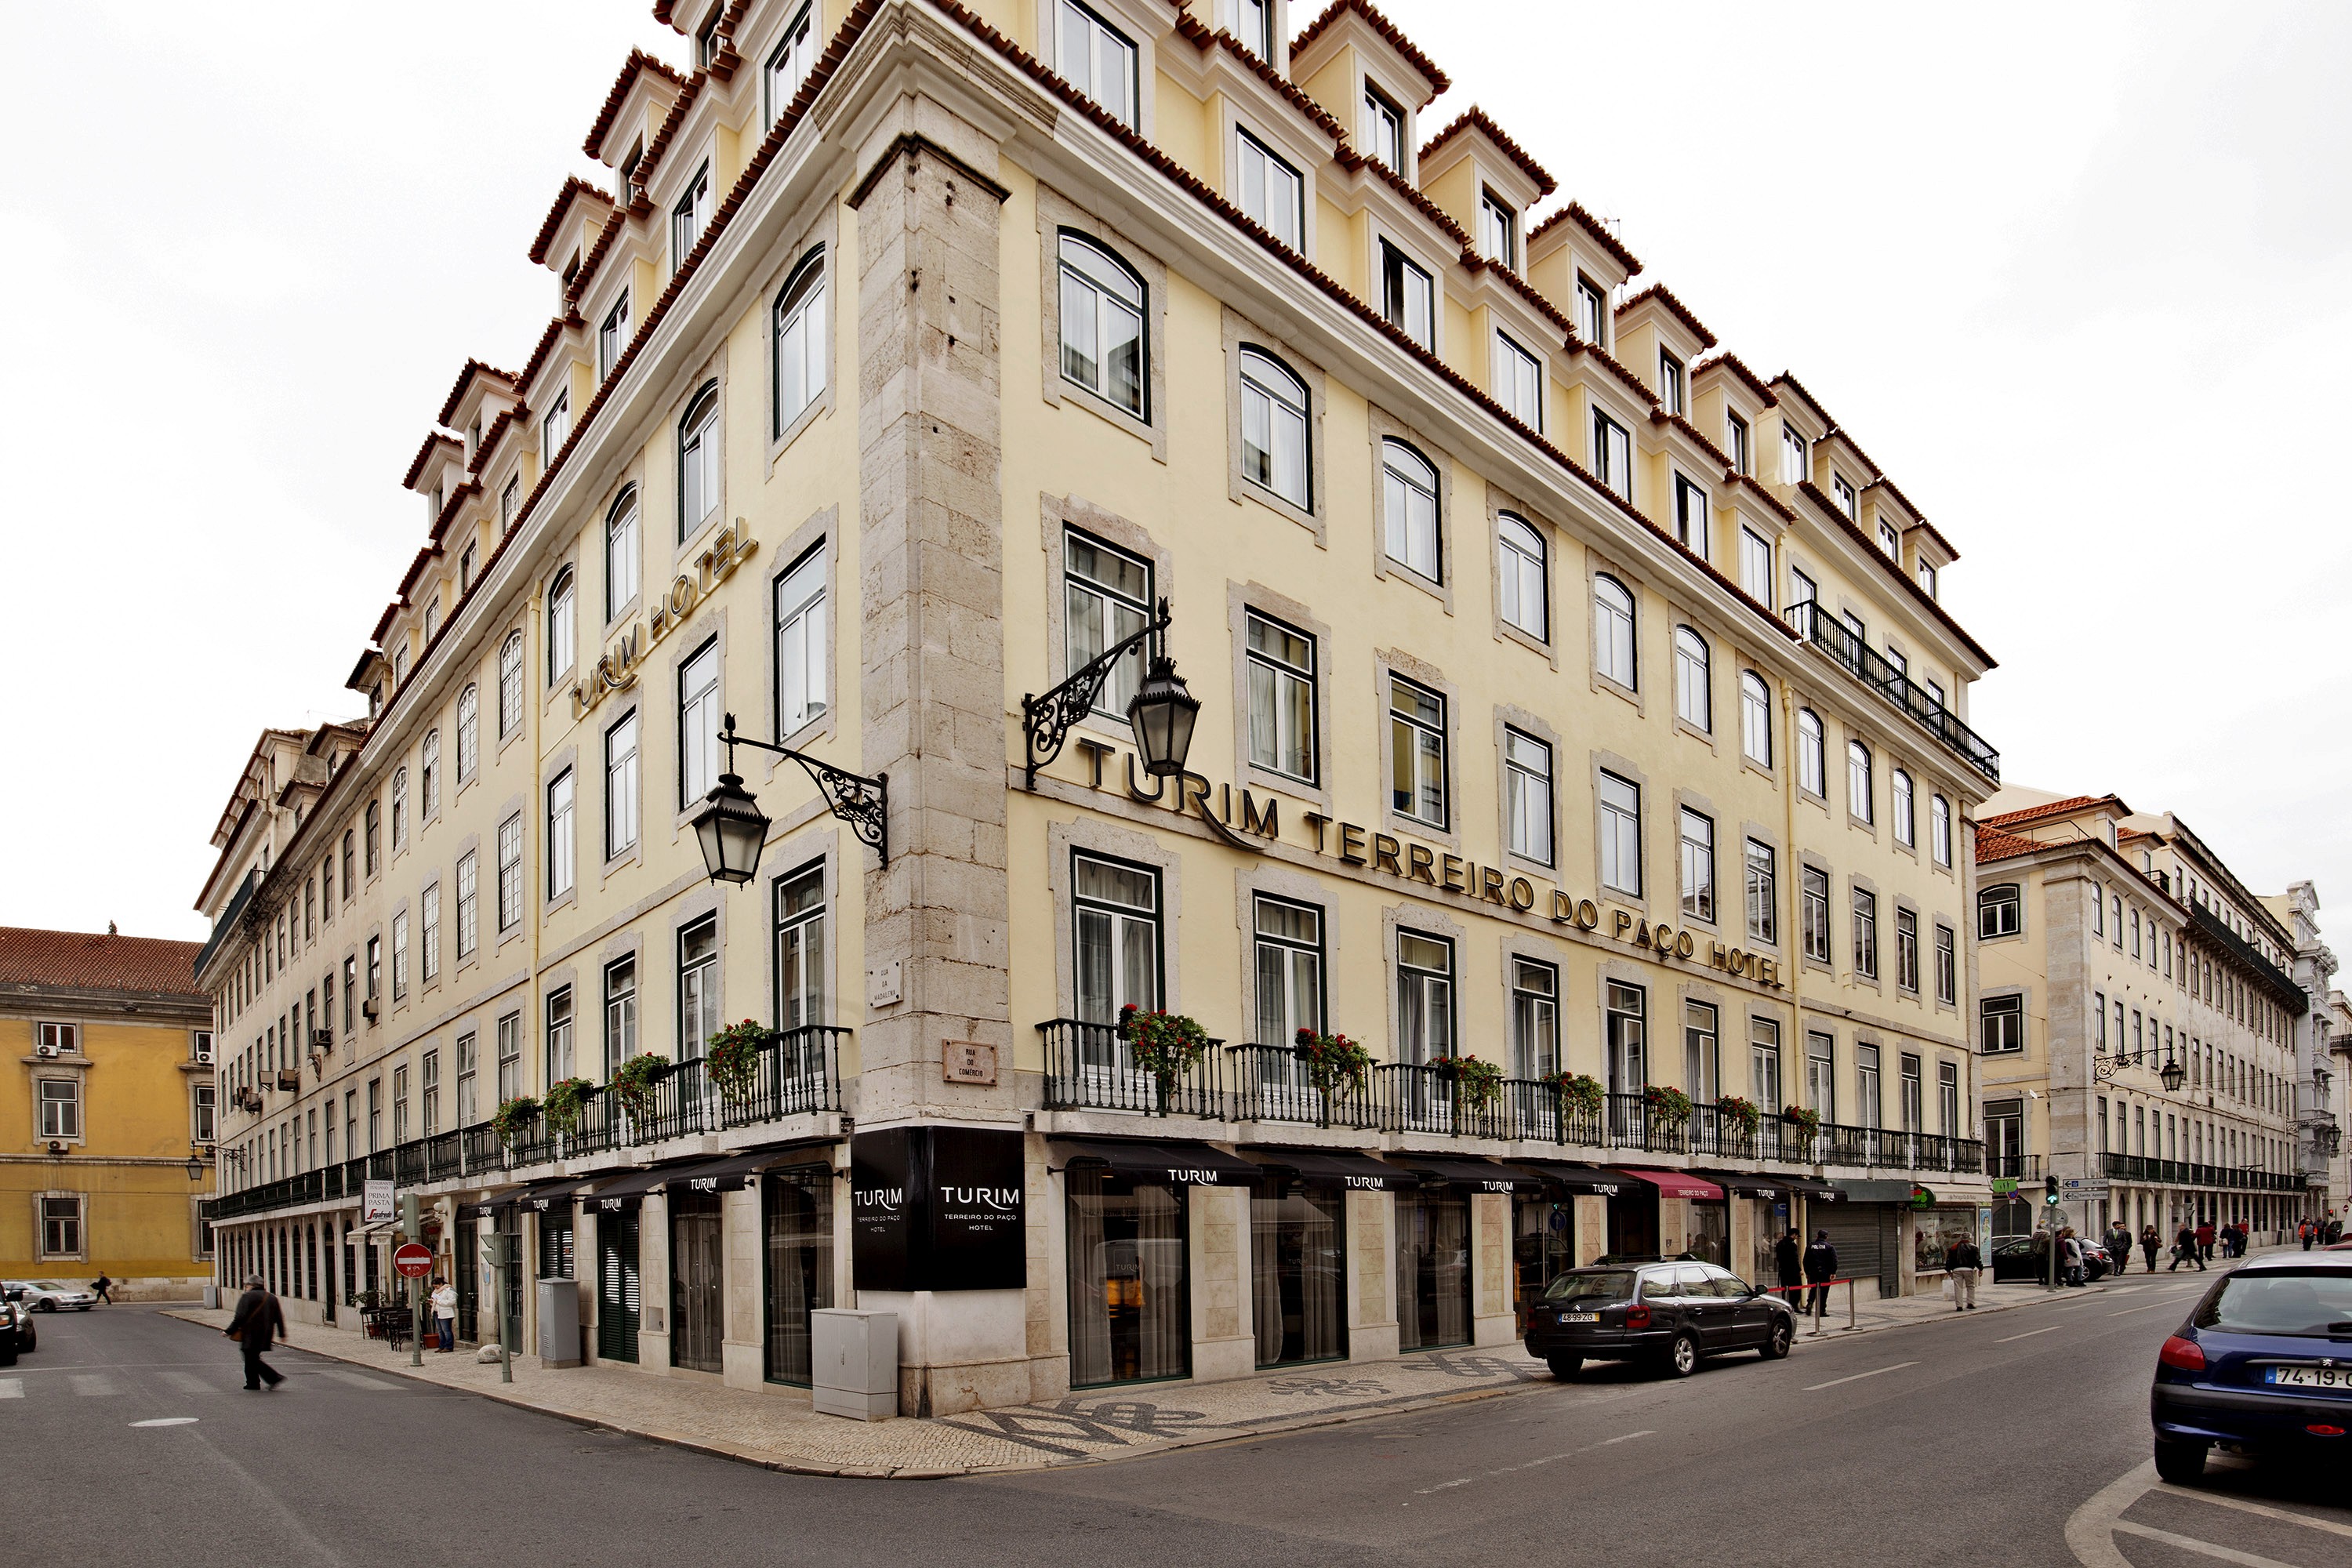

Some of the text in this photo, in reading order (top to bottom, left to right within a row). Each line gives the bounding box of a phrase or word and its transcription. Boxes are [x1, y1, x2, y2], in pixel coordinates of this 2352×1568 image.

[568, 516, 759, 720] TURIM HOTEL
[1075, 737, 1784, 987] TURIM TERREIRO DO PAÇO HOTEL
[959, 1067, 983, 1076] COMÉRCIO
[1167, 1169, 1218, 1185] TURIM
[1345, 1176, 1383, 1191] TURIM
[691, 1177, 717, 1192] TURIM
[1483, 1181, 1513, 1194] TURIM
[1592, 1184, 1618, 1196] TURIM
[855, 1188, 902, 1210] TURIM
[941, 1187, 1018, 1210] TURIM
[1757, 1189, 1775, 1200] TURIM
[1819, 1192, 1835, 1201] TURIM
[533, 1199, 549, 1211] TURIM
[601, 1198, 622, 1211] TURIM
[479, 1207, 492, 1217] TURIM
